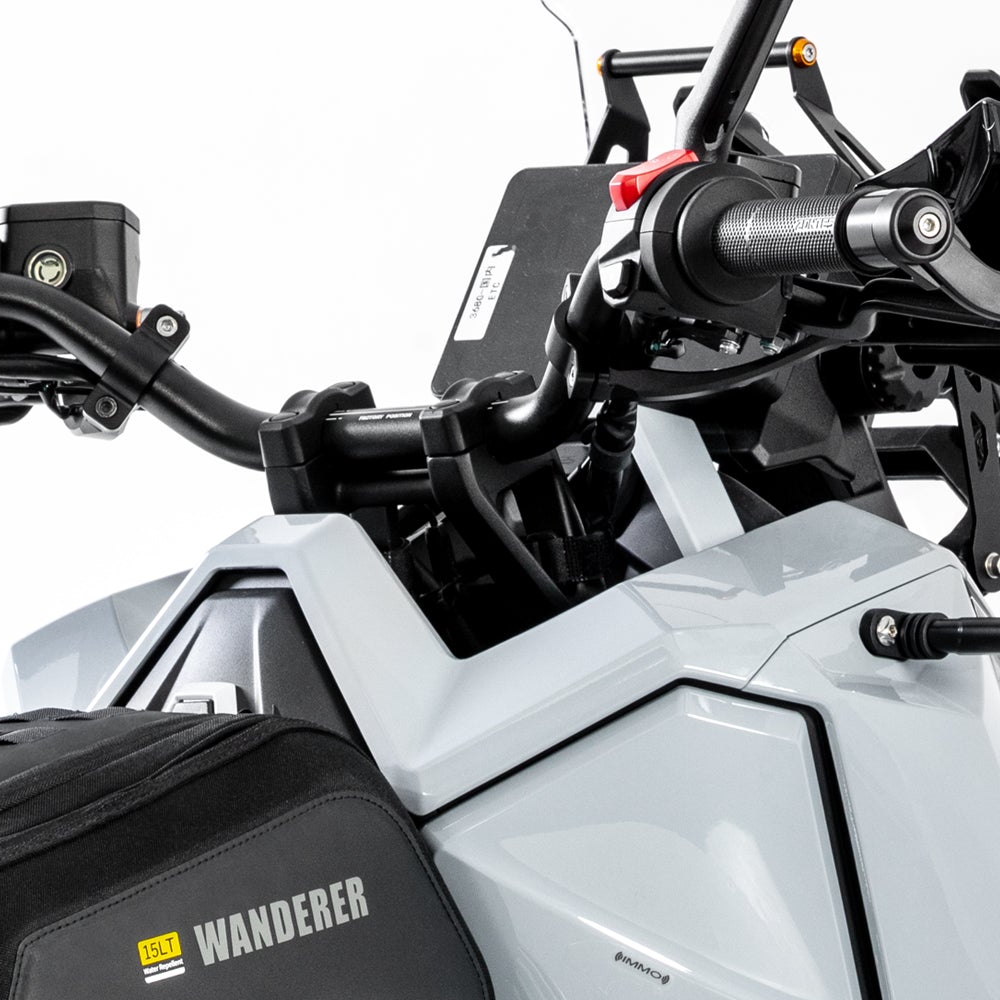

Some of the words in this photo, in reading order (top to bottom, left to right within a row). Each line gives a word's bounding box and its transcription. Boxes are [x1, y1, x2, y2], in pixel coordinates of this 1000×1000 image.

[488, 282, 501, 300] ETC
[193, 876, 370, 966] WANDERER
[142, 936, 175, 960] 15LT
[622, 956, 662, 979] IMMO
